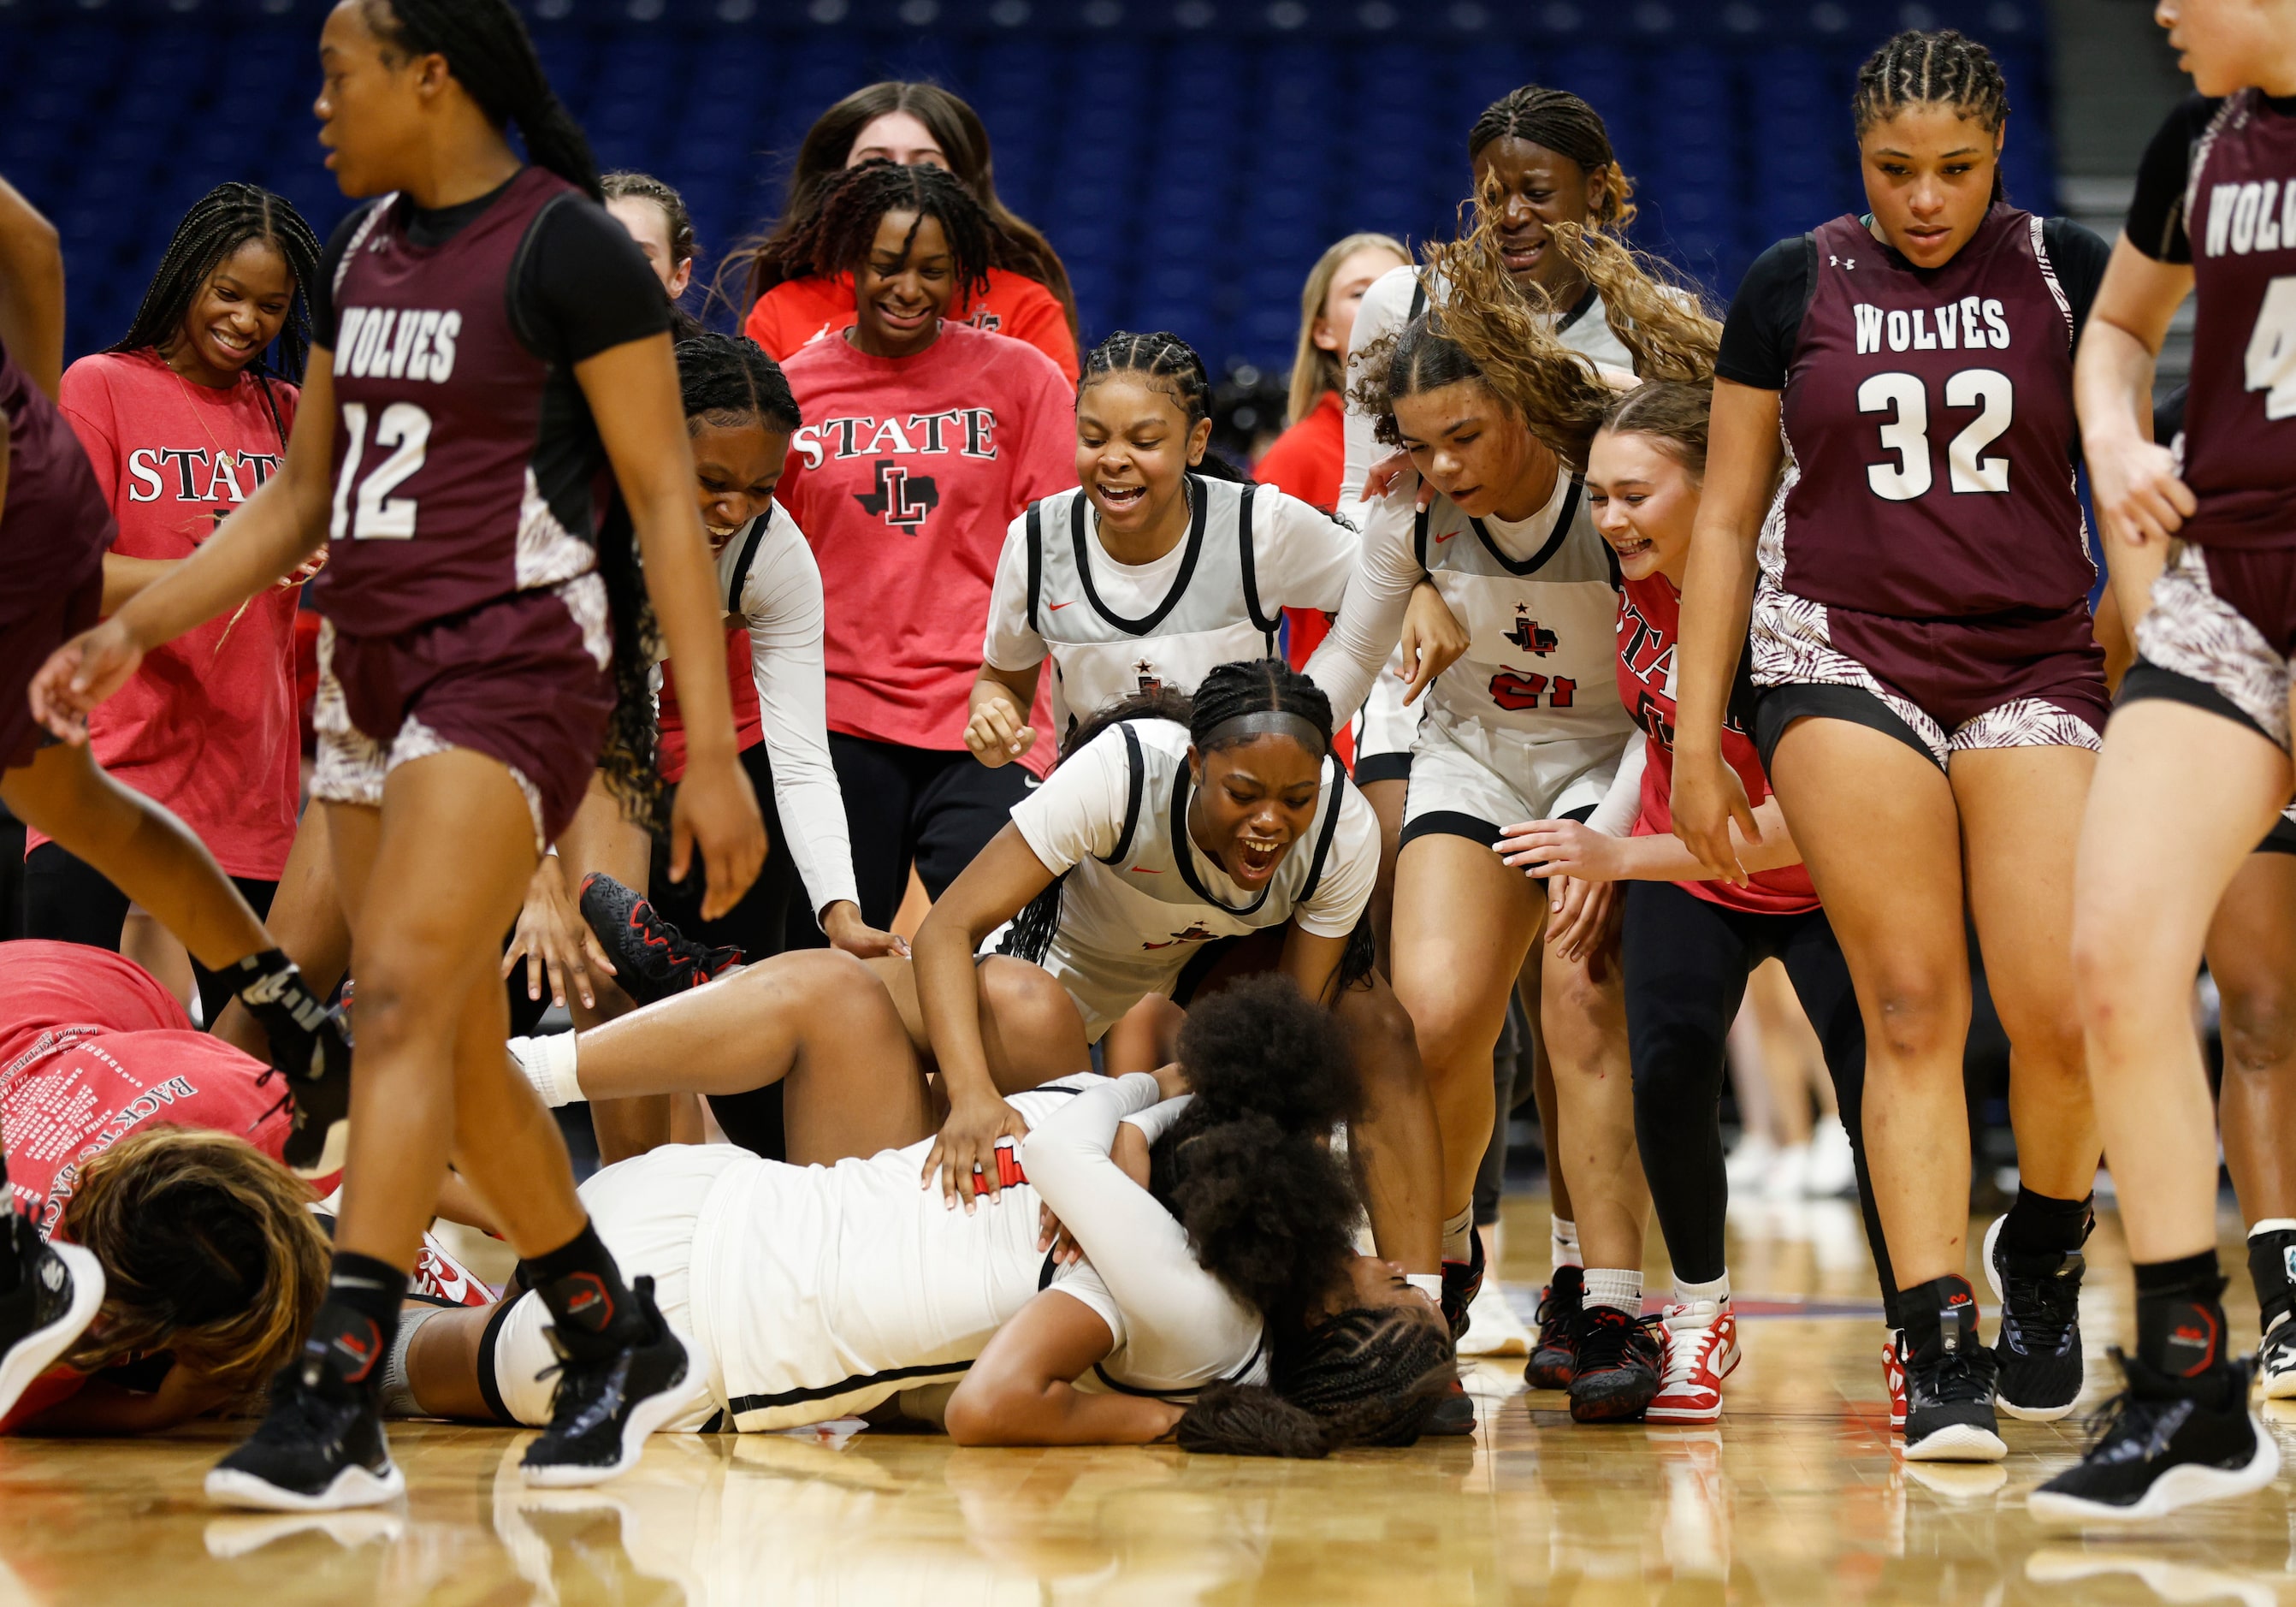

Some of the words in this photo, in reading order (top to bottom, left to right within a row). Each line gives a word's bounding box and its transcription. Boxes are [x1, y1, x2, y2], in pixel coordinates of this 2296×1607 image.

[334, 306, 462, 384] WOLVES
[1853, 296, 2011, 354] WOLVES
[792, 407, 998, 470] STATE
[1857, 369, 2014, 501] 32
[128, 446, 285, 502] STAT
[329, 402, 432, 539] 12
[883, 466, 926, 525] L
[1488, 664, 1577, 710] 21
[12, 1077, 42, 1111] NATALIA
[36, 1076, 64, 1104] LILIAN
[41, 1068, 82, 1111] SAMANTHA
[50, 1095, 70, 1114] TINA
[110, 1075, 198, 1131] BACK
[5, 1106, 38, 1144] JOHNSON
[26, 1123, 56, 1158] MURPHY
[29, 1116, 51, 1139] WEBB
[33, 1124, 68, 1159] WARRIOR
[84, 1109, 112, 1134] AZIYAH
